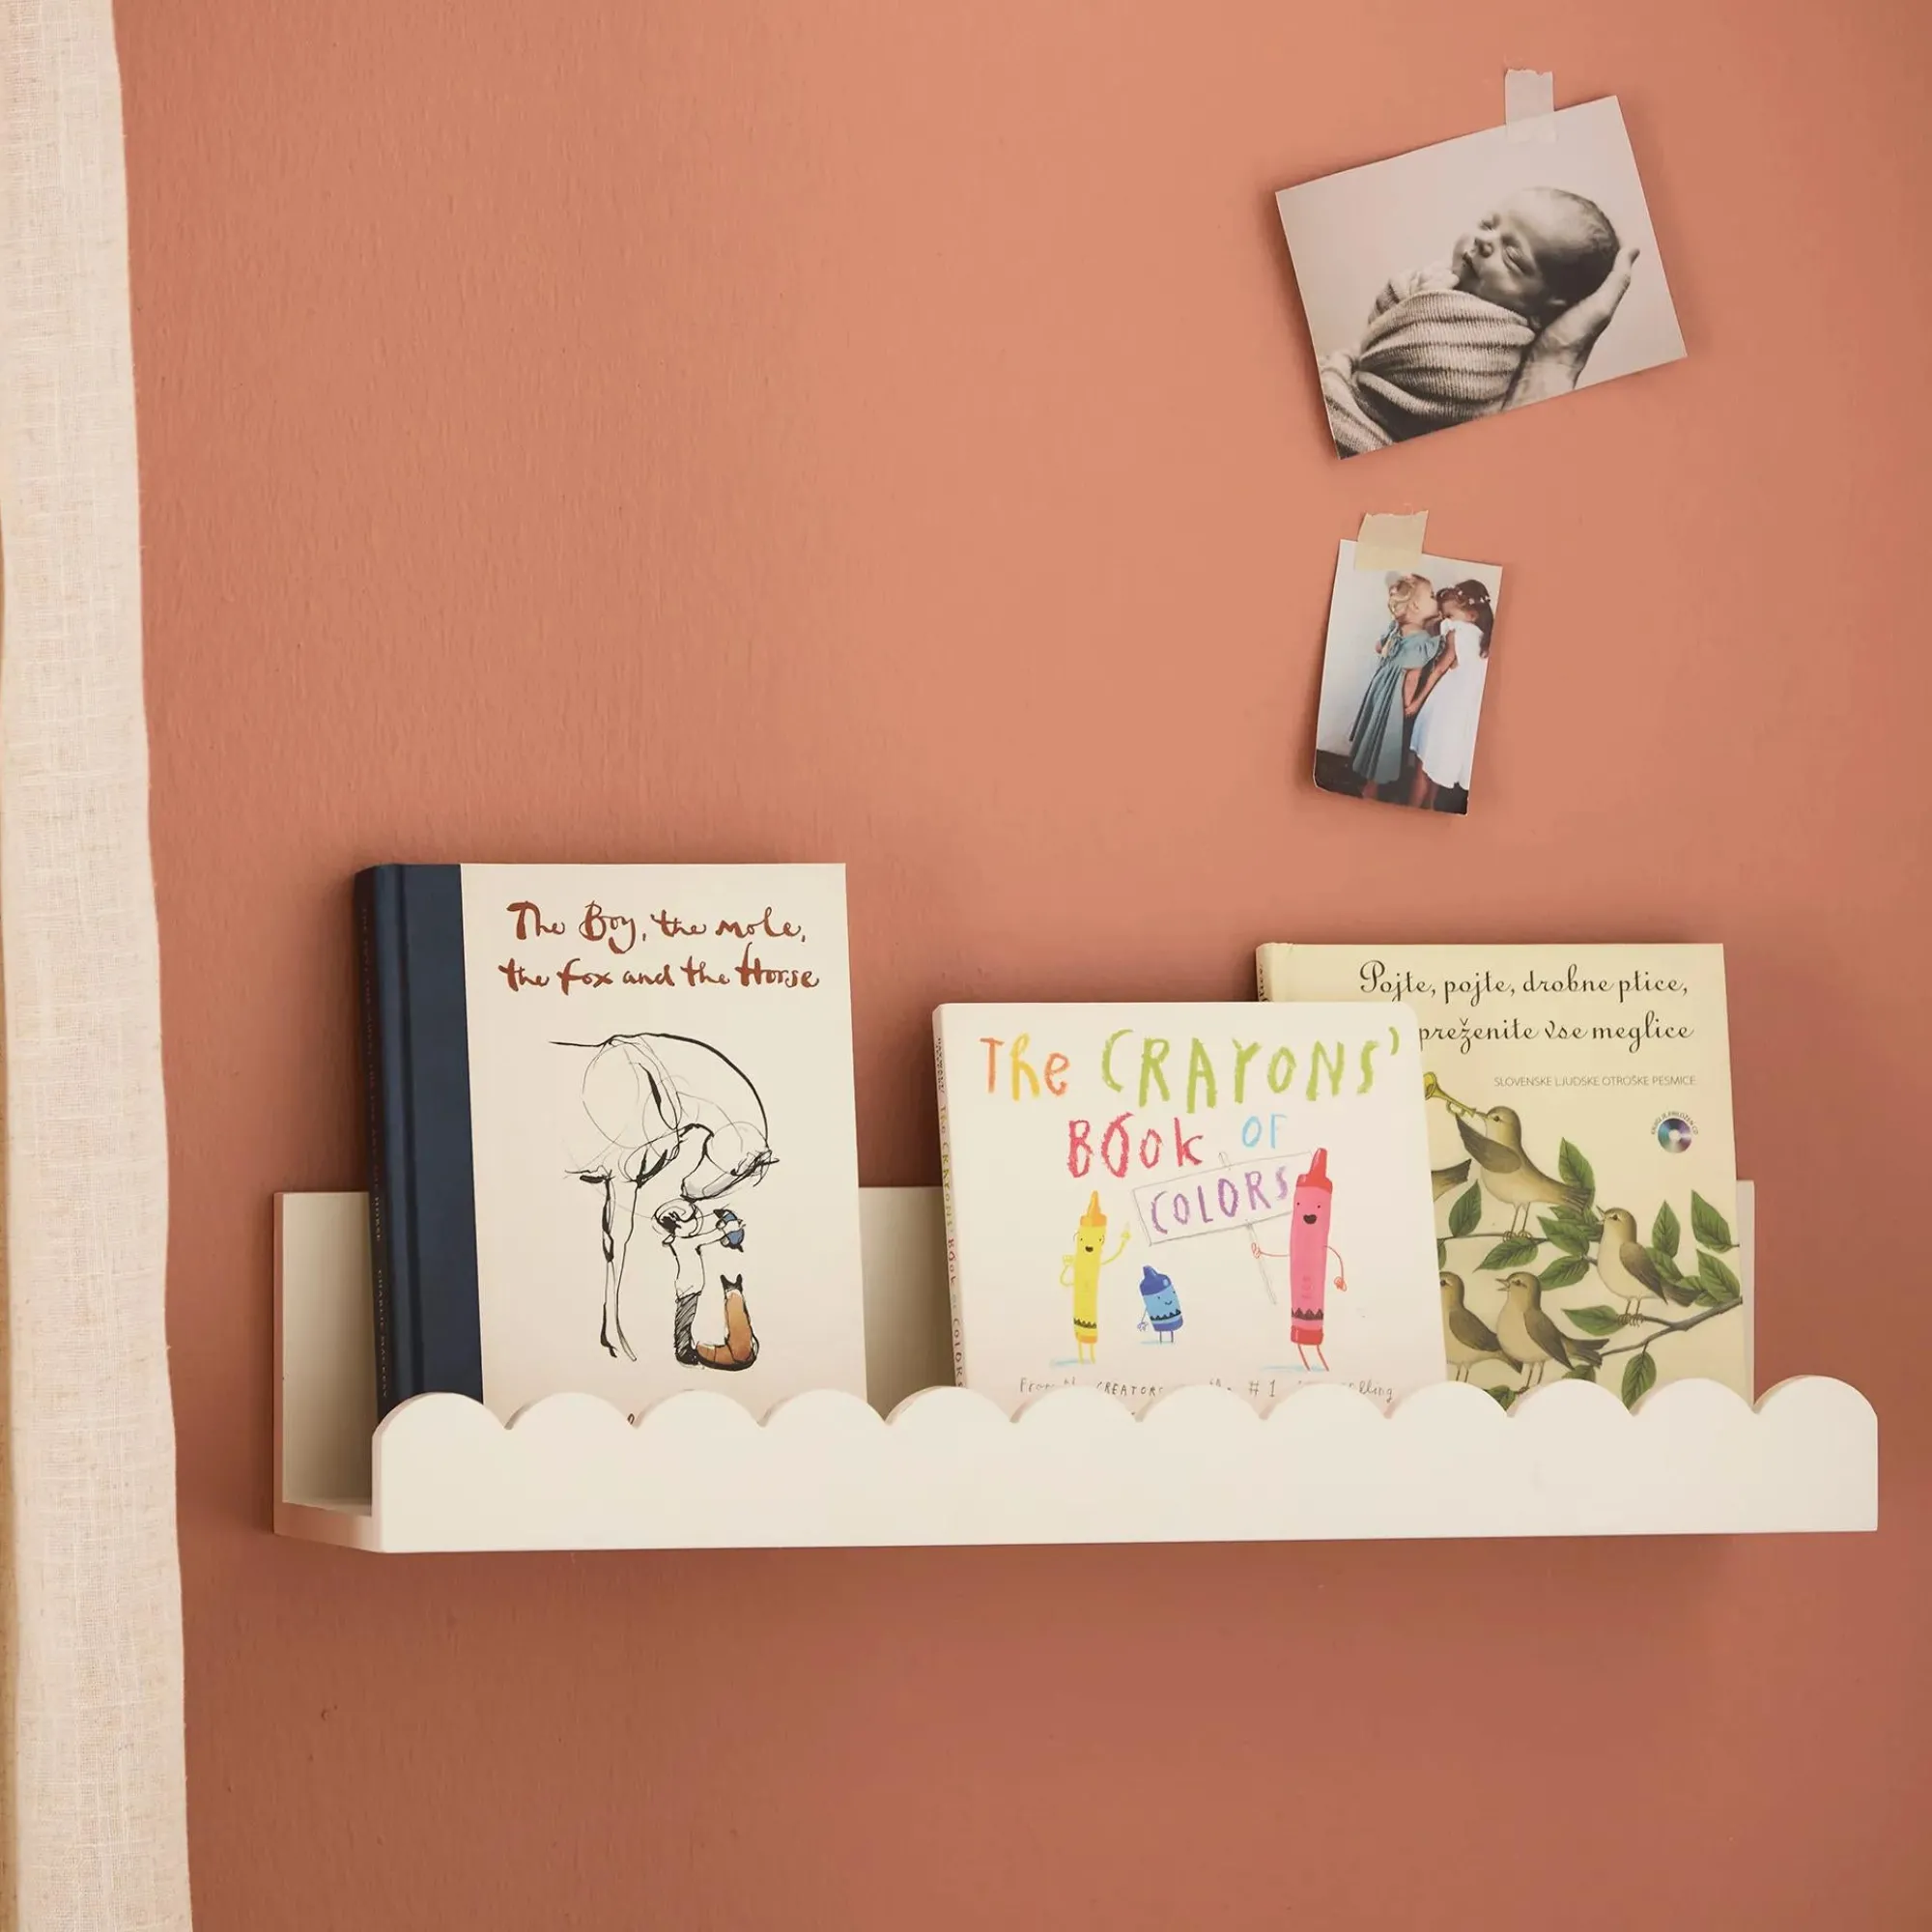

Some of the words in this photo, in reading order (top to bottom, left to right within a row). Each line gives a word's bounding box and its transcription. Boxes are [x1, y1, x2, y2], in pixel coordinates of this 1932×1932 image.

[505, 899, 566, 941] The
[578, 899, 647, 955] Boy,
[649, 908, 707, 938] the
[714, 906, 807, 946] mole,
[497, 957, 551, 993] the
[555, 957, 614, 996] fox
[621, 963, 676, 987] and
[679, 954, 731, 987] the
[733, 938, 820, 989] Horse
[1359, 959, 1436, 1003] Pojte,
[1444, 970, 1516, 1008] pojte,
[1522, 963, 1611, 993] drobne
[1618, 970, 1688, 1004] ptice,
[1544, 1019, 1588, 1039] vse
[1592, 1009, 1694, 1054] meglice
[979, 1033, 1071, 1102] The
[1150, 1165, 1289, 1235] COLORS
